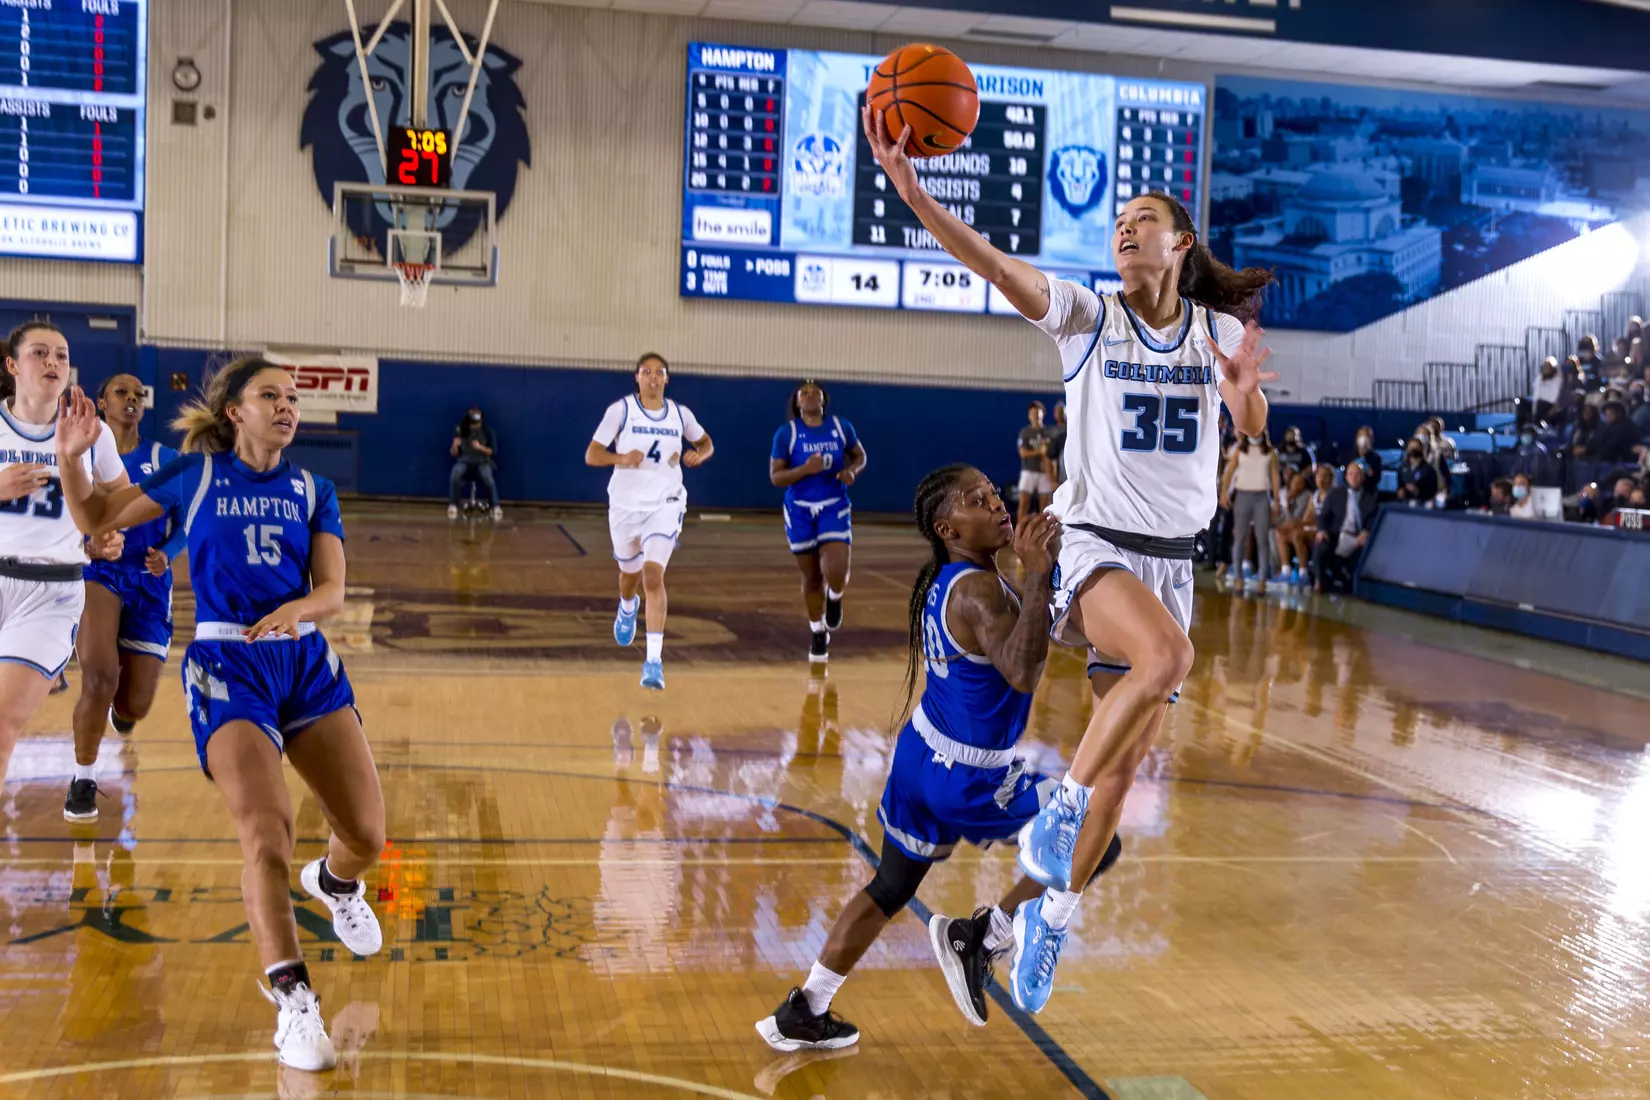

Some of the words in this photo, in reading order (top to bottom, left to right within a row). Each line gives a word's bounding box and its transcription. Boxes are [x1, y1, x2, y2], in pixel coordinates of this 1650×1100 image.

[701, 48, 775, 71] HAMPTON
[976, 75, 1044, 98] ARISON
[1119, 84, 1200, 105] COLUMBIA
[406, 129, 447, 155] 7:05
[398, 149, 439, 184] 27
[918, 176, 981, 202] ASSISTS
[2, 216, 35, 232] ETIC
[41, 217, 107, 236] BREWING
[698, 218, 722, 234] the
[727, 219, 767, 236] smile
[687, 250, 697, 269] 0
[851, 274, 880, 292] 14
[919, 269, 971, 288] 7:05
[1104, 360, 1212, 385] COLUMBIA
[631, 425, 679, 438] COLUMBIA
[1120, 392, 1200, 455] 35
[646, 440, 661, 463] 4
[802, 441, 839, 453] HAMPTON
[215, 496, 302, 523] HAMPTON
[243, 523, 284, 566] 15
